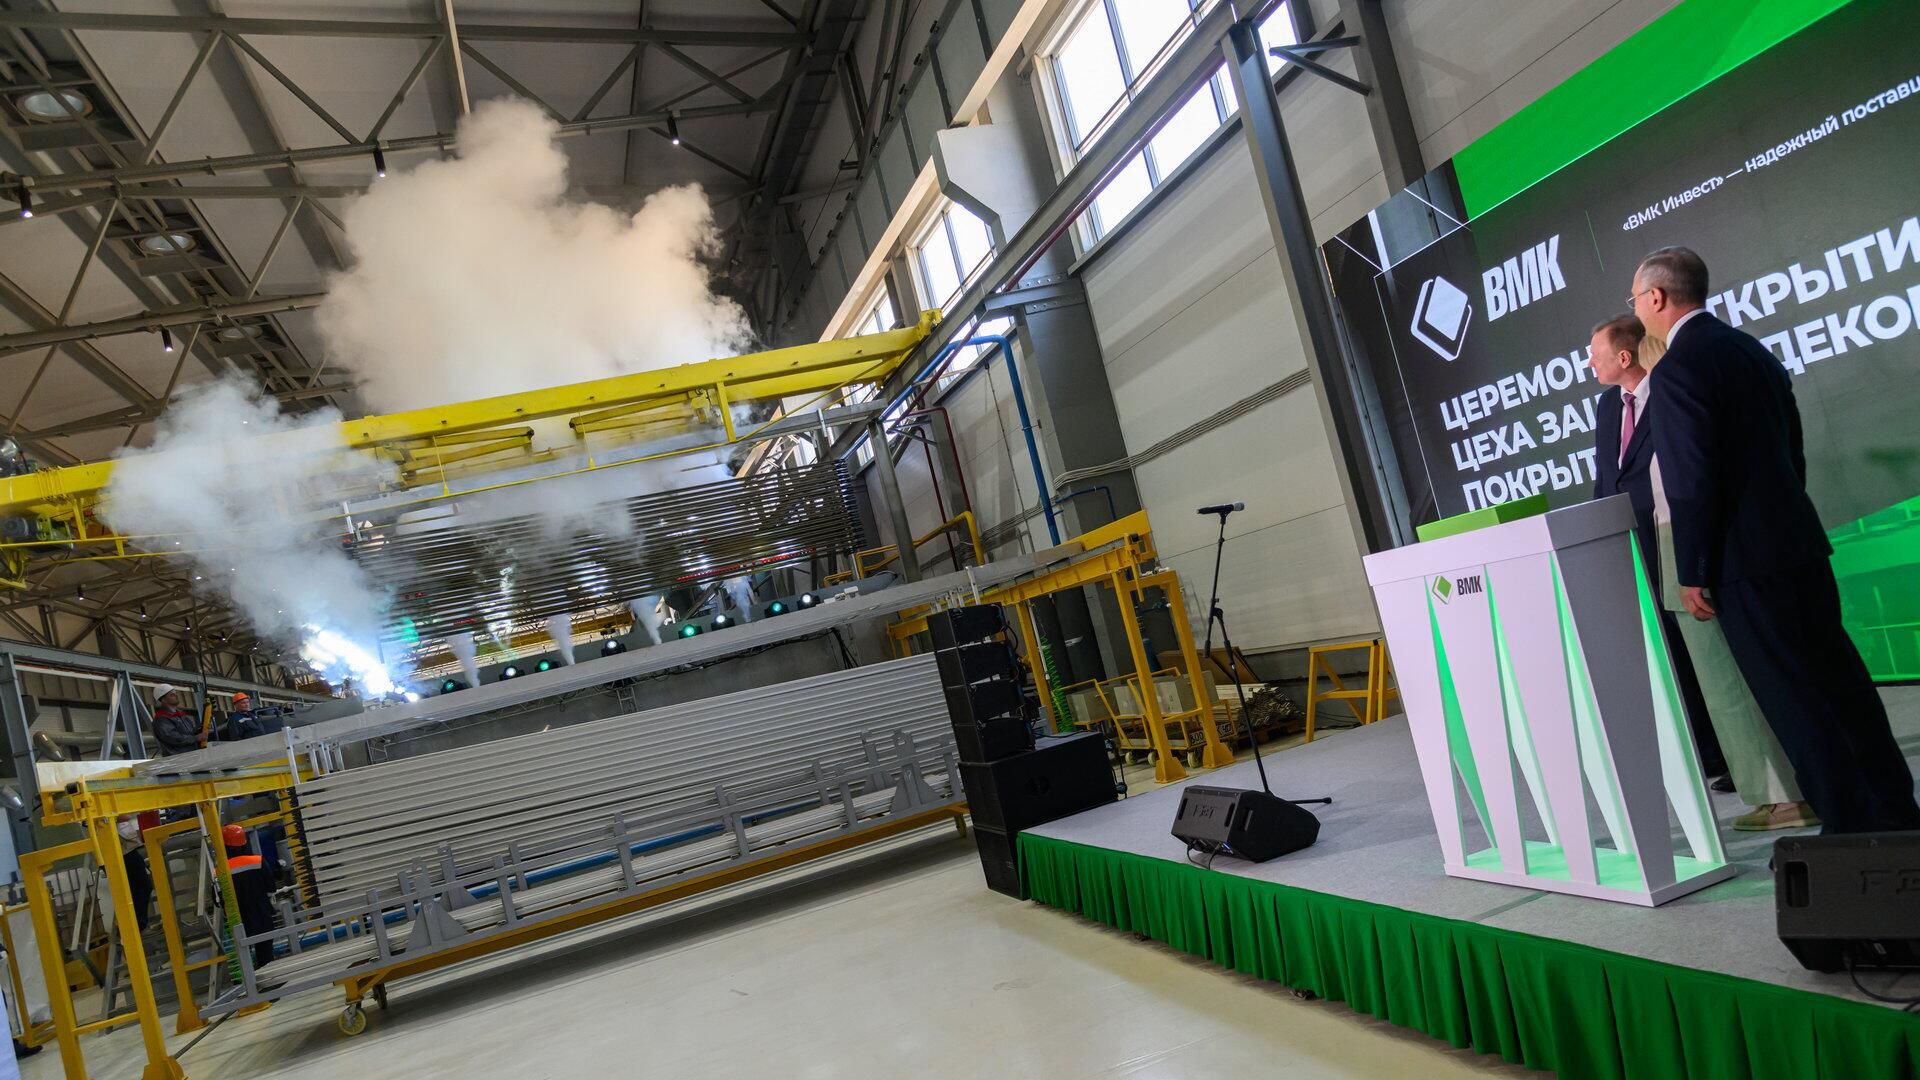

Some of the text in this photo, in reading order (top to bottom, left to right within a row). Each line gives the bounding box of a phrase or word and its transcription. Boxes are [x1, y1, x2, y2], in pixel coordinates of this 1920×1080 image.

[1622, 201, 1662, 231] «ВМК
[1662, 176, 1724, 213] Инвест»
[1745, 115, 1839, 173] надежный
[1482, 234, 1566, 322] ВМК
[1451, 421, 1537, 472] ЦЕХА
[1462, 446, 1597, 512] ПОКРЫТ
[1456, 575, 1482, 596] ВМК
